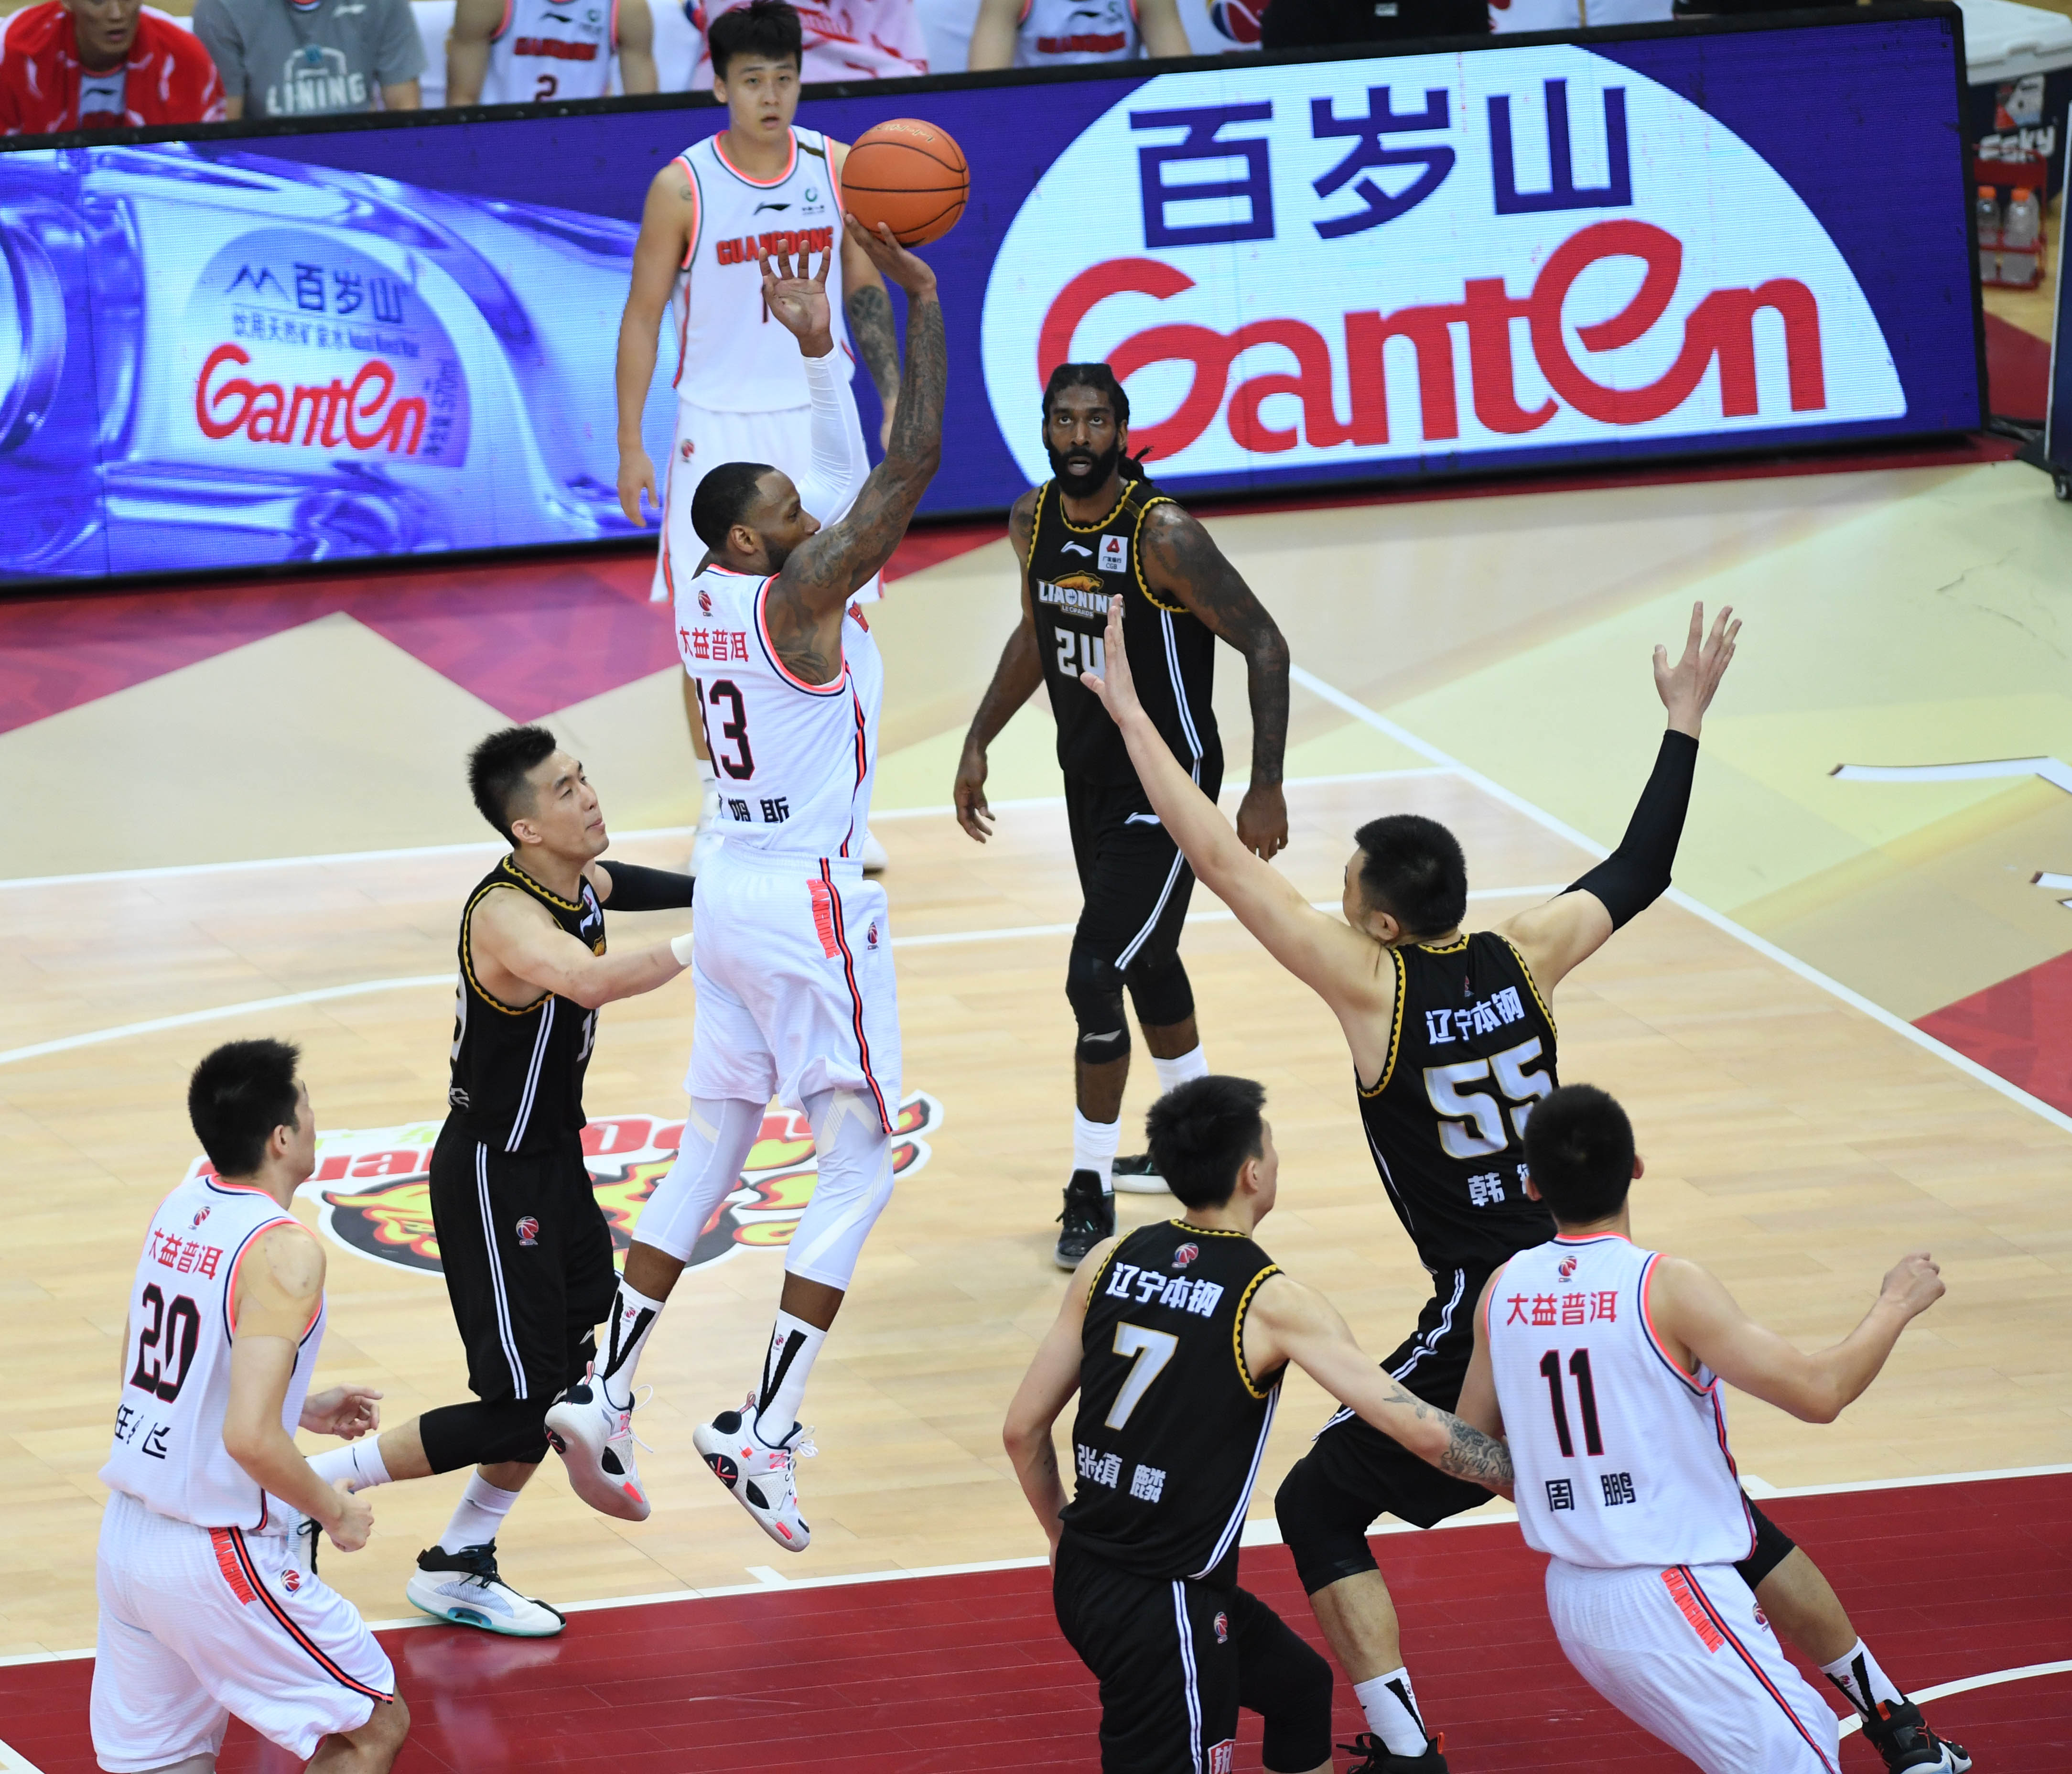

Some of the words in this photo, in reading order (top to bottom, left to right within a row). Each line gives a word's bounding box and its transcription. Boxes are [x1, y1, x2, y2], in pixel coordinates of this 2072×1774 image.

[267, 72, 366, 115] LINING
[1129, 79, 1632, 248] 百岁山
[294, 263, 402, 323] 百岁山
[1037, 219, 1826, 465] Ganten
[196, 342, 426, 454] Ganten
[680, 626, 749, 662] 大益普洱
[696, 677, 755, 781] 13
[717, 791, 790, 823] 姆斯
[1425, 985, 1525, 1045] 辽宁本钢
[1423, 1036, 1554, 1159] 55
[149, 1227, 224, 1280] 大益普洱
[1105, 1262, 1224, 1318] 辽宁本钢
[1507, 1291, 1619, 1326] 大益普洱
[130, 1281, 201, 1405] 20
[1104, 1321, 1179, 1431] 7
[1540, 1348, 1605, 1458] 11
[115, 1404, 171, 1460] 任飞
[1545, 1471, 1637, 1512] 周鹏
[1661, 1566, 1725, 1654] GUANGDONG
